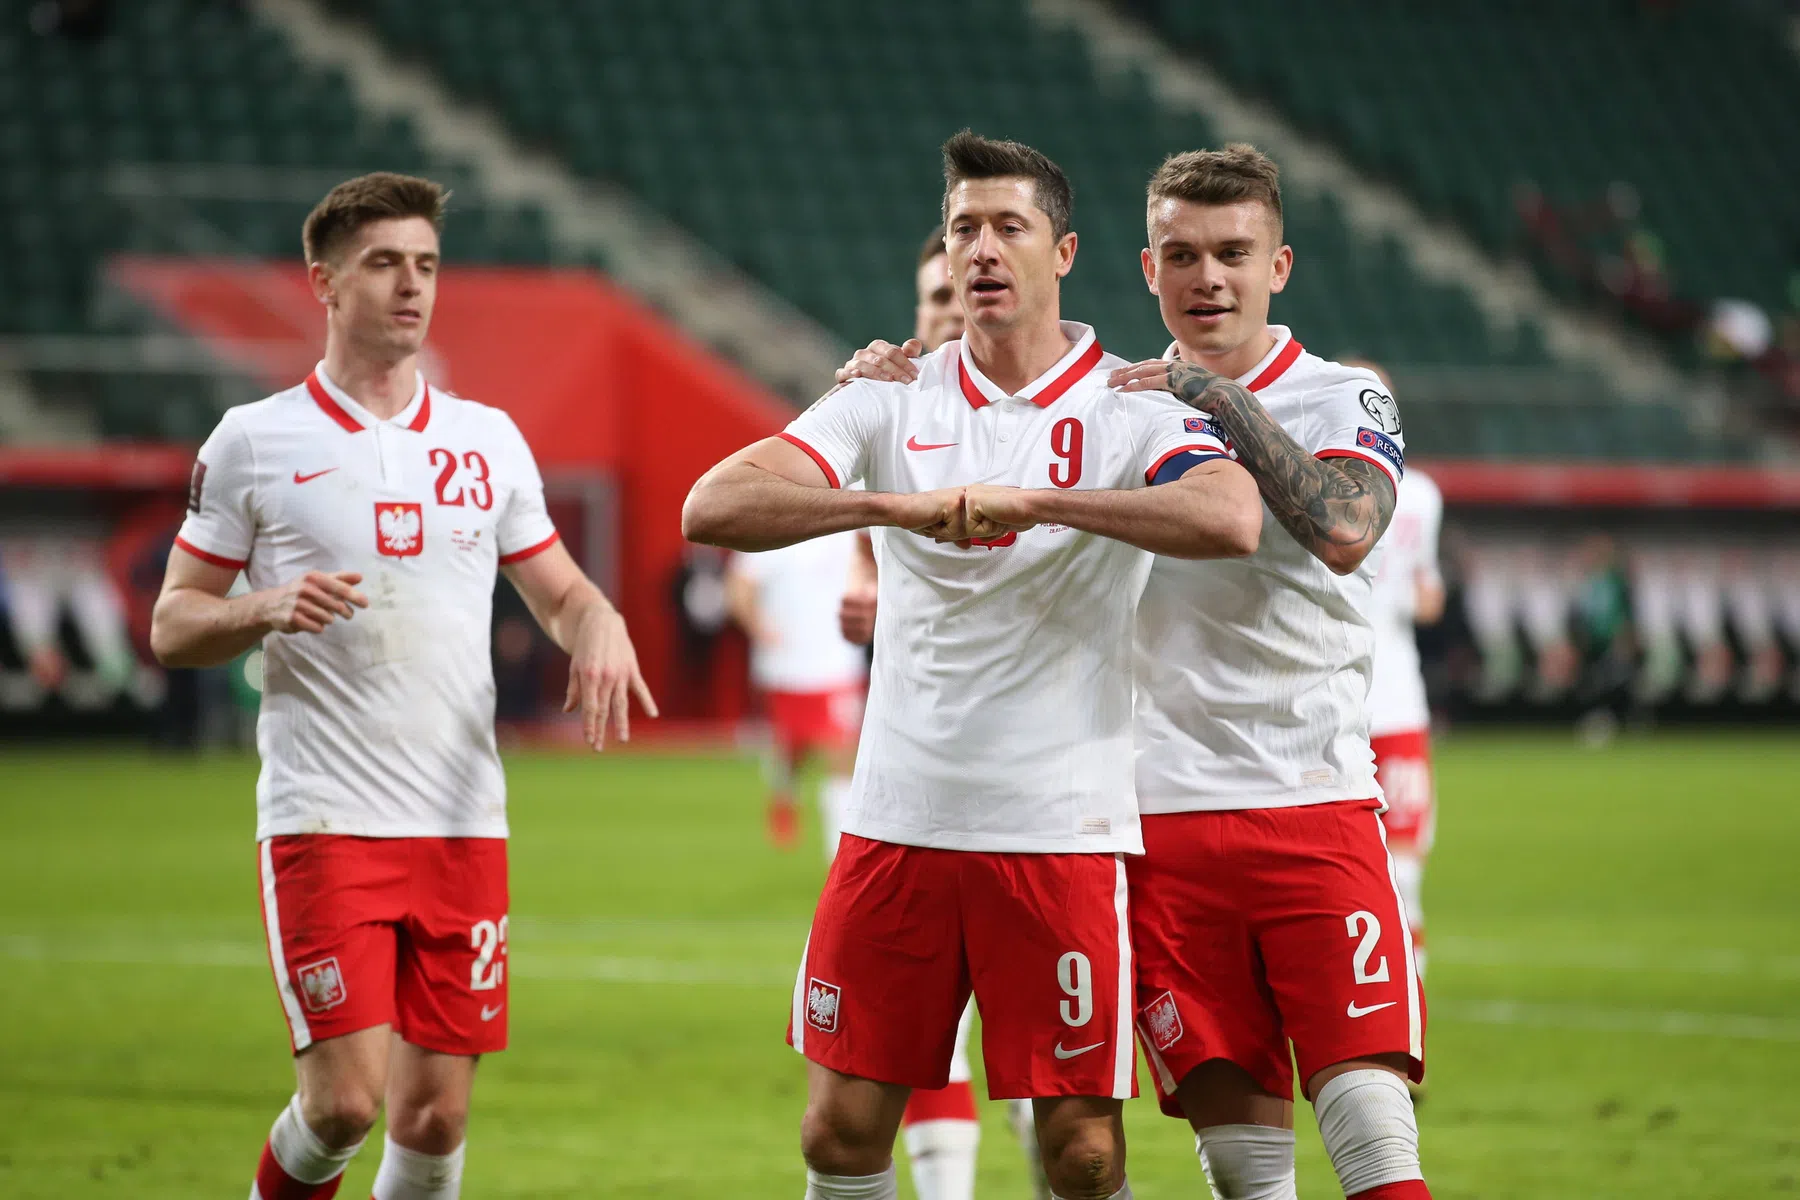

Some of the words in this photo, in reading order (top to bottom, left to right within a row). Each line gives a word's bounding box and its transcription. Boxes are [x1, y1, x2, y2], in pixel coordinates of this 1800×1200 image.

[428, 447, 493, 511] 23
[1048, 417, 1084, 489] 9
[1377, 439, 1405, 471] RESPEC
[1345, 910, 1390, 985] 2
[1057, 951, 1093, 1027] 9
